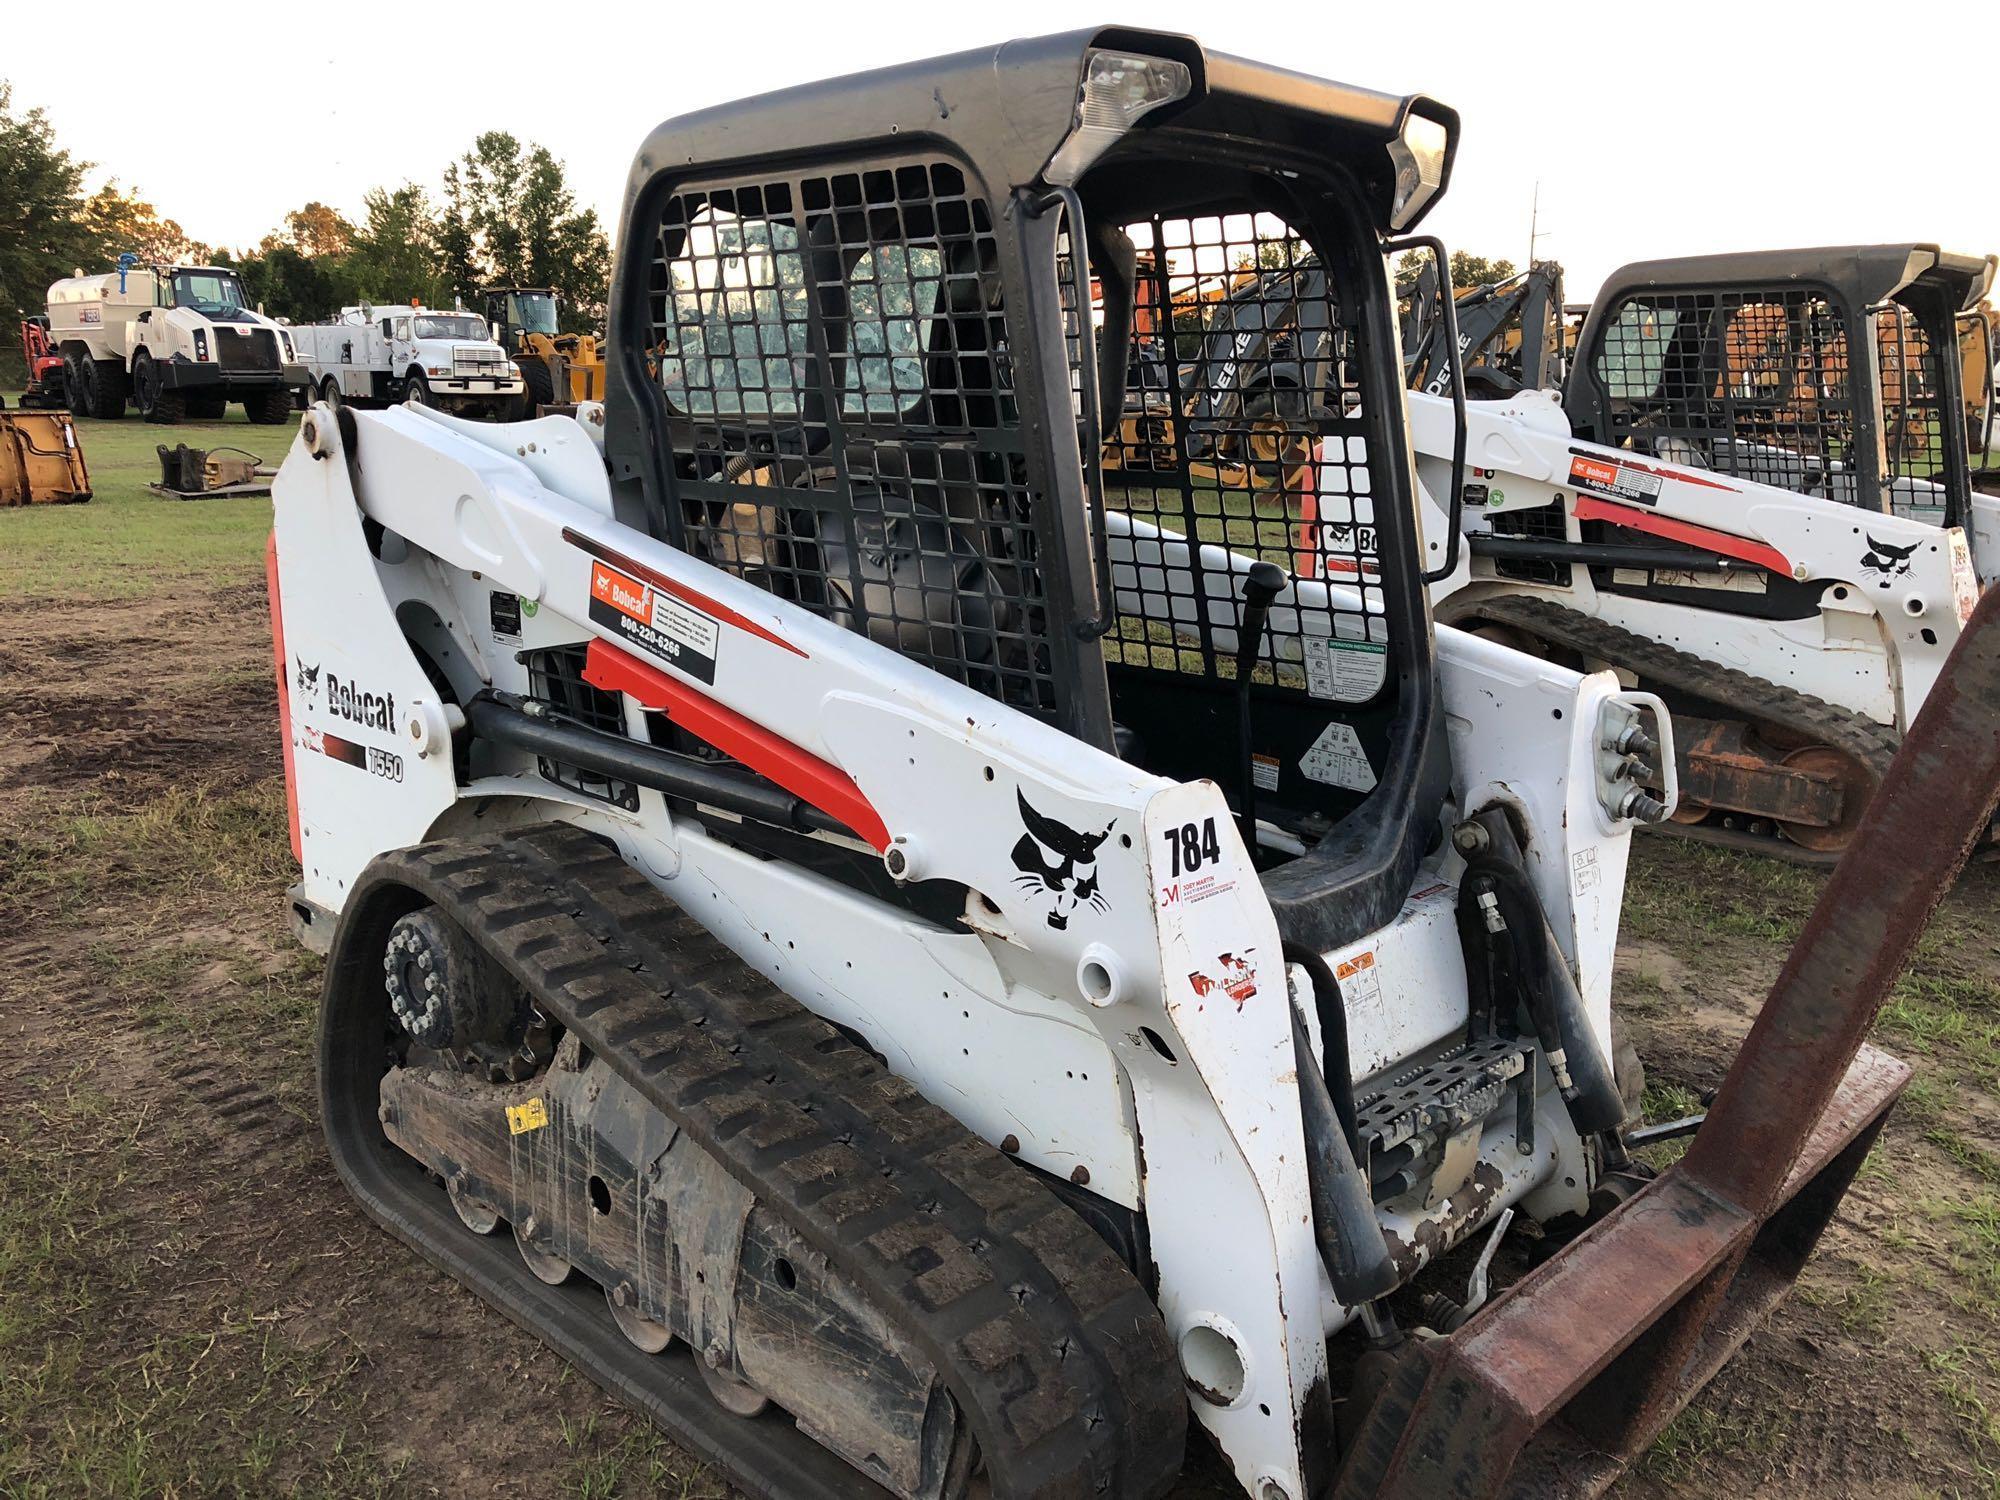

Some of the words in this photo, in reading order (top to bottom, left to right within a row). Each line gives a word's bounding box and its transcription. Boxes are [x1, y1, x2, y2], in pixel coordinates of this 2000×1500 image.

[1586, 467, 1611, 480] Bobcat
[612, 584, 646, 616] Bobcat
[620, 615, 680, 657] 800-220-6266
[326, 672, 396, 735] Bobcat
[368, 746, 404, 784] T550
[1164, 817, 1220, 878] 784
